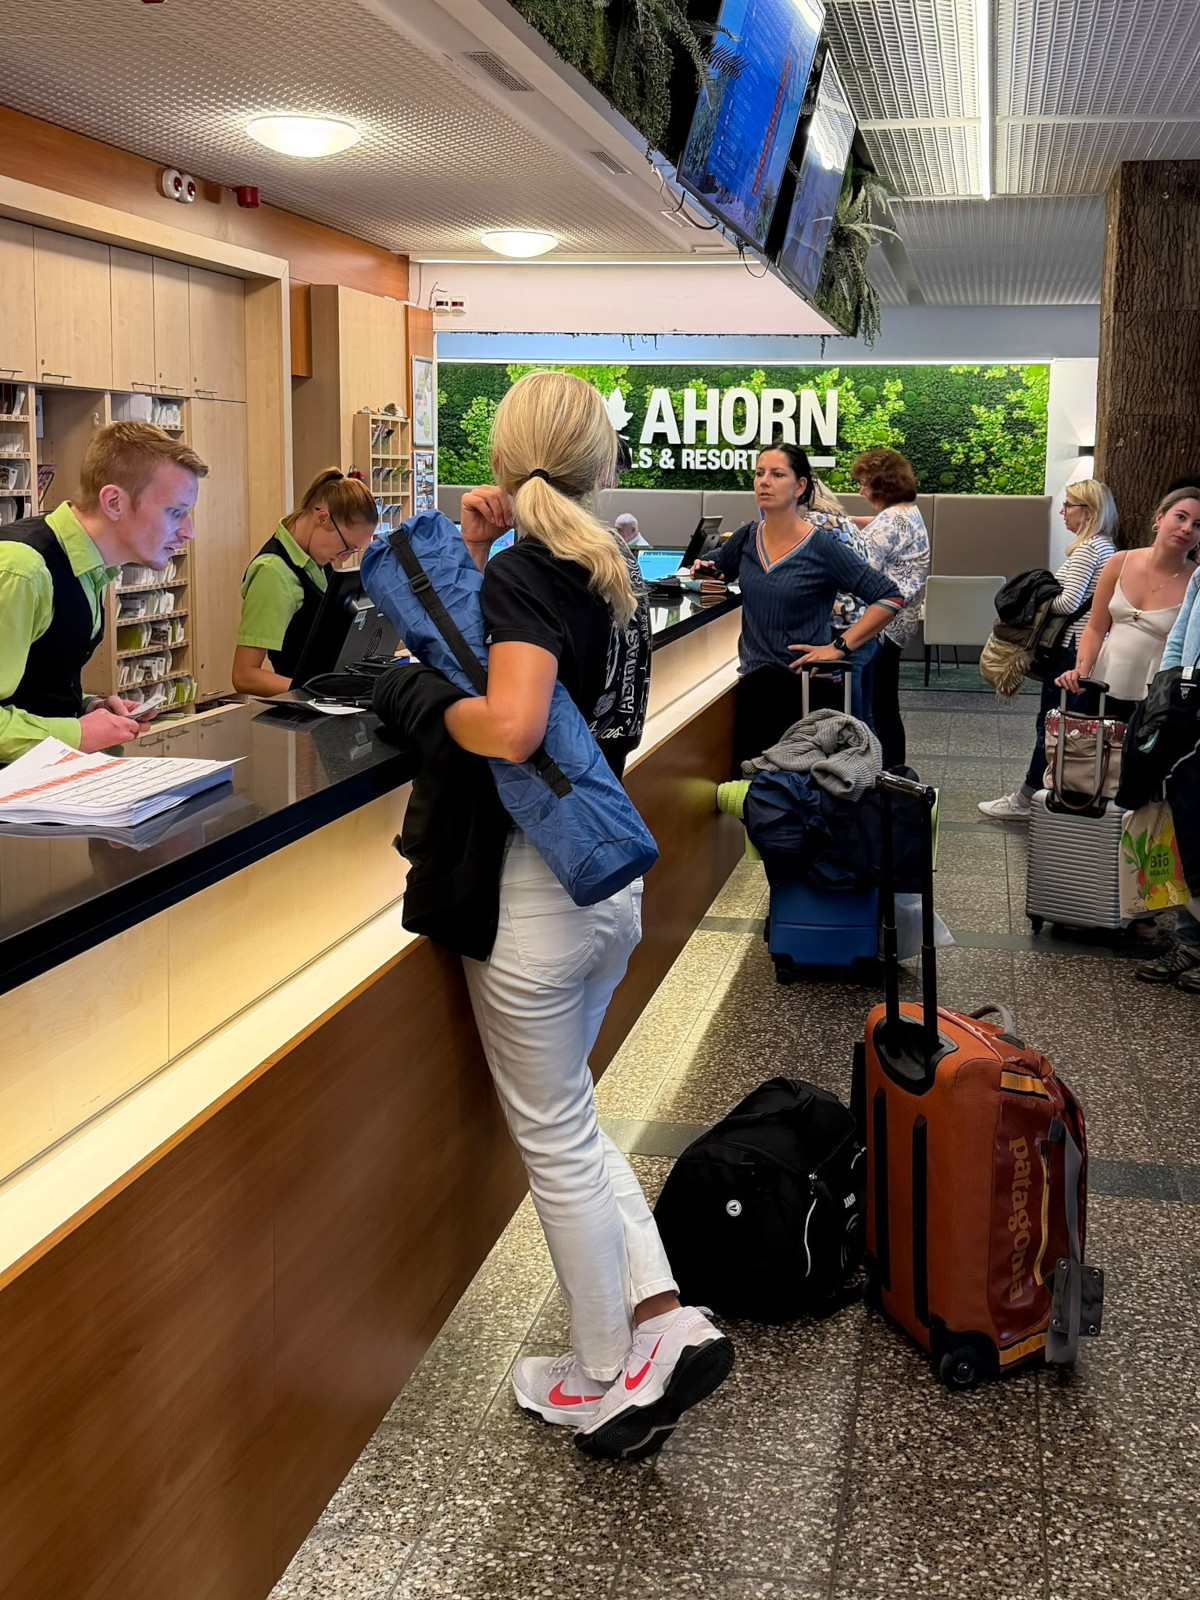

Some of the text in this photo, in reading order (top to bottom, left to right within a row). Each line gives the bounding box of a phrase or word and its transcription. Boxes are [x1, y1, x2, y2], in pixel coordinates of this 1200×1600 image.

[640, 388, 838, 445] AHORN
[658, 447, 675, 470] &
[681, 449, 759, 470] RESORT
[1008, 1135, 1032, 1302] patagonia
